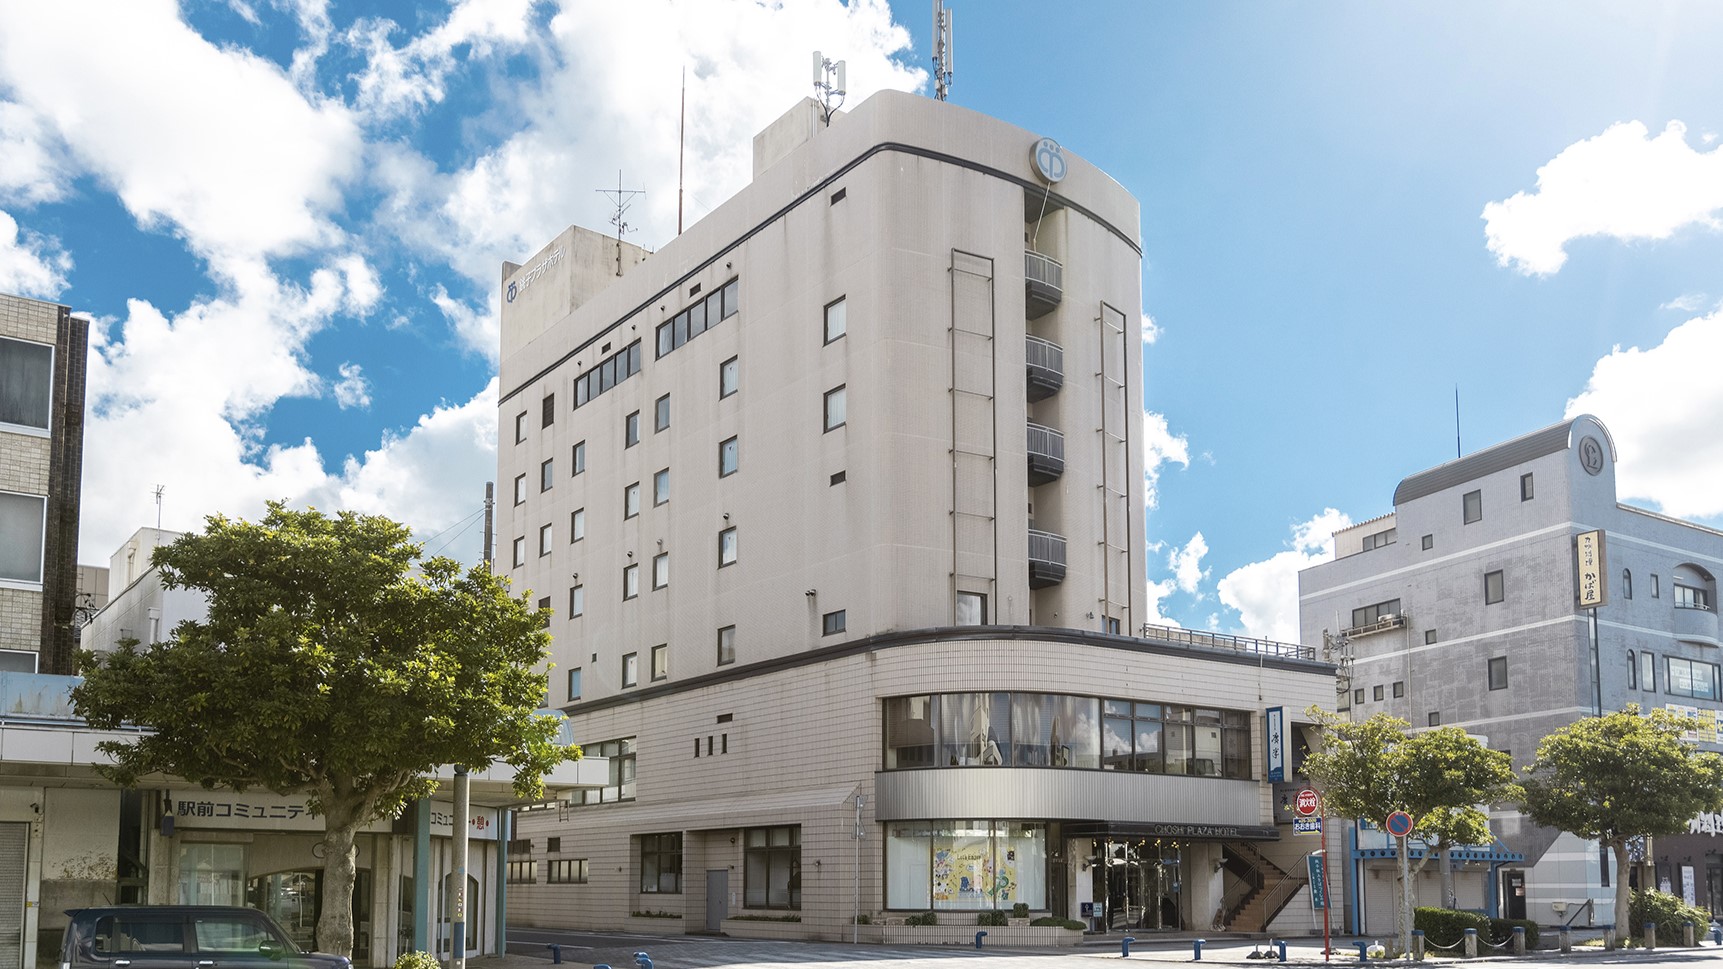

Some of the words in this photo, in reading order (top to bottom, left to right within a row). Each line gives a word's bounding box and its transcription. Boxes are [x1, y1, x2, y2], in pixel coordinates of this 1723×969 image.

[1584, 572, 1596, 601] かば屋
[1299, 797, 1316, 808] 消火栓
[1155, 824, 1184, 836] CHOSHI
[1187, 825, 1212, 837] PLAZA
[1215, 826, 1239, 838] HOTEL
[1294, 822, 1321, 831] おおき歯科
